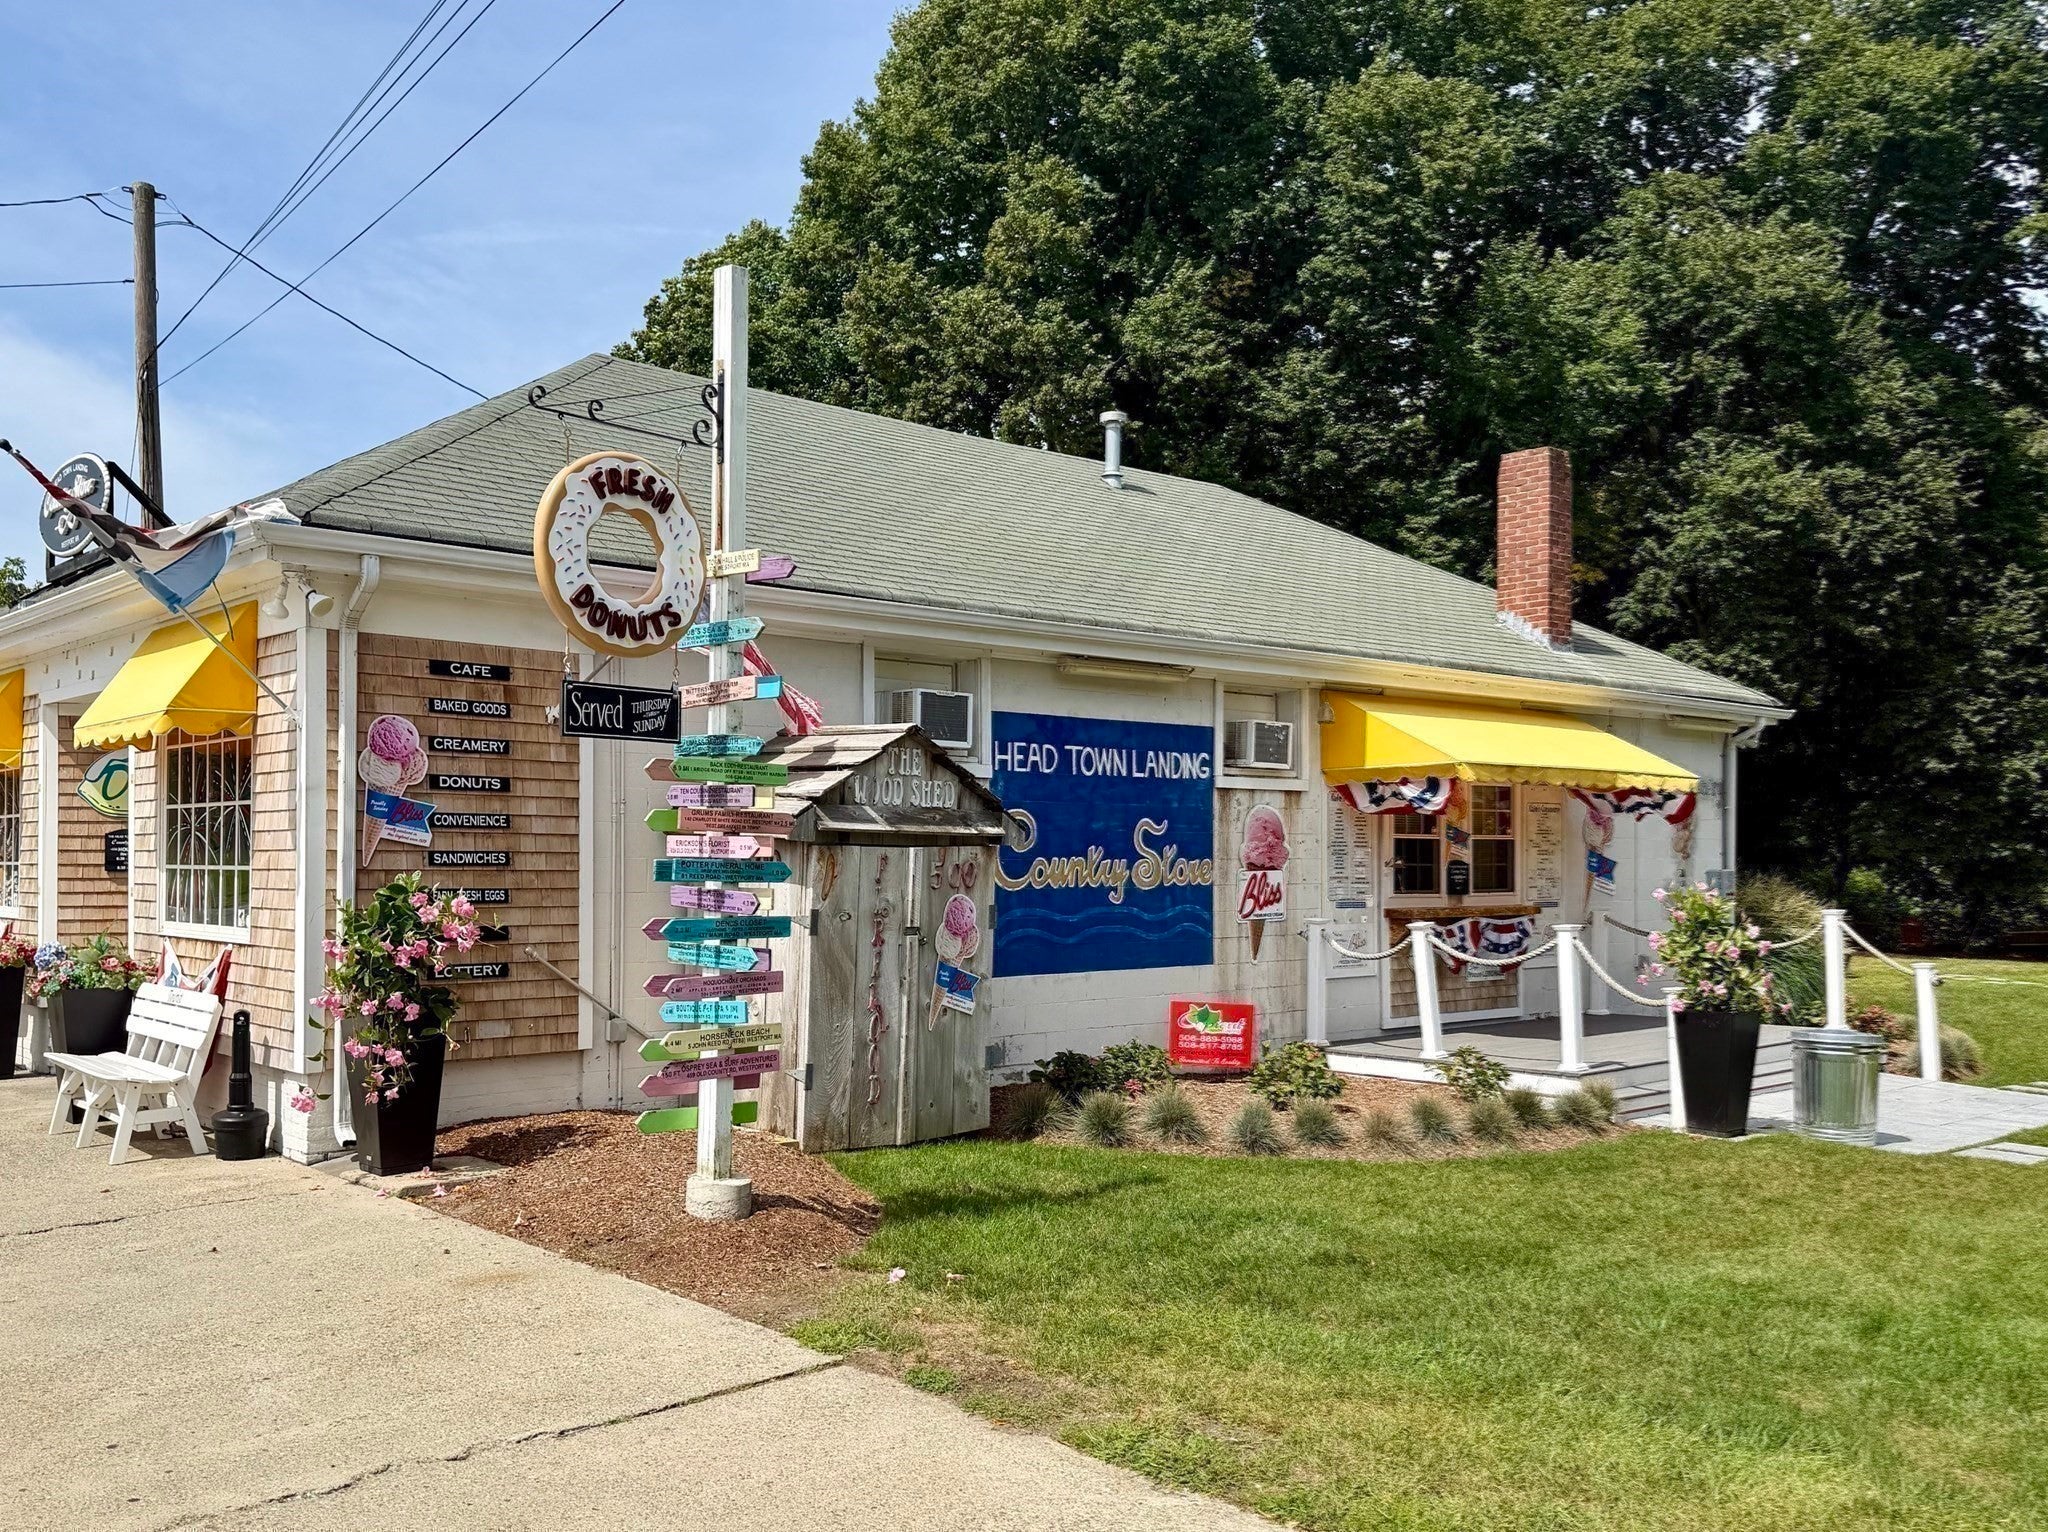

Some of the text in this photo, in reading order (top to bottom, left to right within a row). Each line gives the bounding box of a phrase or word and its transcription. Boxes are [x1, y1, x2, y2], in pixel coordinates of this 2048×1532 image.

[589, 467, 675, 514] FRESH
[569, 583, 682, 641] DONUTS
[450, 663, 491, 677] CAFE
[434, 700, 507, 715] BAKED GOODS
[569, 691, 623, 729] Served
[631, 698, 672, 714] THURSDAY
[632, 715, 667, 733] SUNDAY
[433, 737, 506, 753] CREAMERY
[735, 763, 768, 771] RESTAURANT
[888, 747, 923, 777] THE
[994, 741, 1210, 780] HEAD TOWN LANDING
[439, 776, 501, 790] DONUTS
[911, 779, 956, 809] SHED
[391, 801, 425, 825] Bliss
[714, 810, 734, 818] FAMILY
[735, 811, 774, 820] RESTAURANT
[433, 814, 507, 827] CONVENIENCE
[708, 840, 730, 848] FLORIST
[433, 853, 506, 864] SANDWICHES
[994, 808, 1213, 904] Country Store
[681, 860, 765, 870] POTTER FUNERAL HOME
[458, 890, 482, 901] RESH
[484, 890, 506, 901] EGGS
[1238, 871, 1282, 919] Bliss
[740, 918, 766, 926] CLOSET
[740, 975, 767, 984] ORCHARDS
[700, 1027, 770, 1041] HORSENECK BEACH
[746, 1035, 773, 1043] WESTPORT
[681, 1063, 705, 1074] OSPREY
[706, 1061, 718, 1070] SEA
[724, 1058, 739, 1068] SURF
[740, 1054, 778, 1066] ADVENTURES
[738, 1063, 764, 1072] WESTPORT
